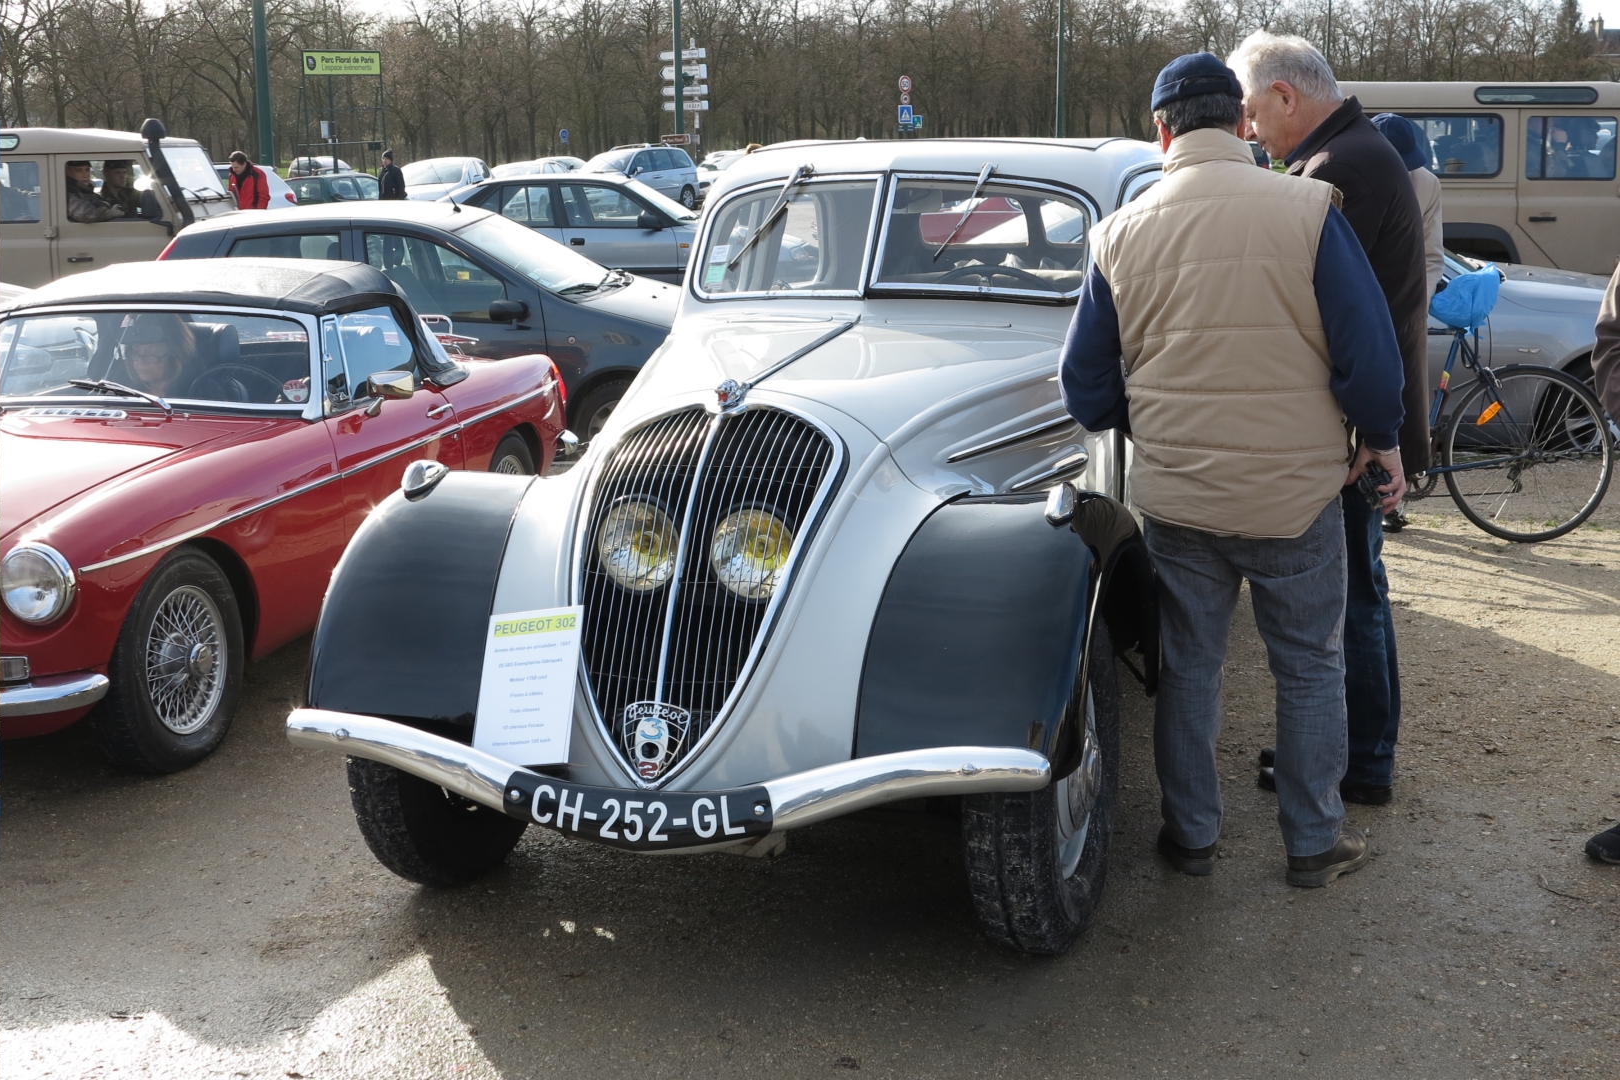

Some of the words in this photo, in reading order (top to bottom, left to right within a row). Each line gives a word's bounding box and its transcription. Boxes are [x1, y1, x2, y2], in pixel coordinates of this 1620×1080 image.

[320, 56, 334, 64] Parc
[335, 56, 351, 64] Floral
[352, 56, 360, 64] de
[360, 56, 375, 64] Paris
[321, 64, 343, 72] L'espace
[494, 619, 553, 635] PEUGEOT
[555, 617, 576, 629] 302
[531, 784, 746, 842] CH-252-GL
